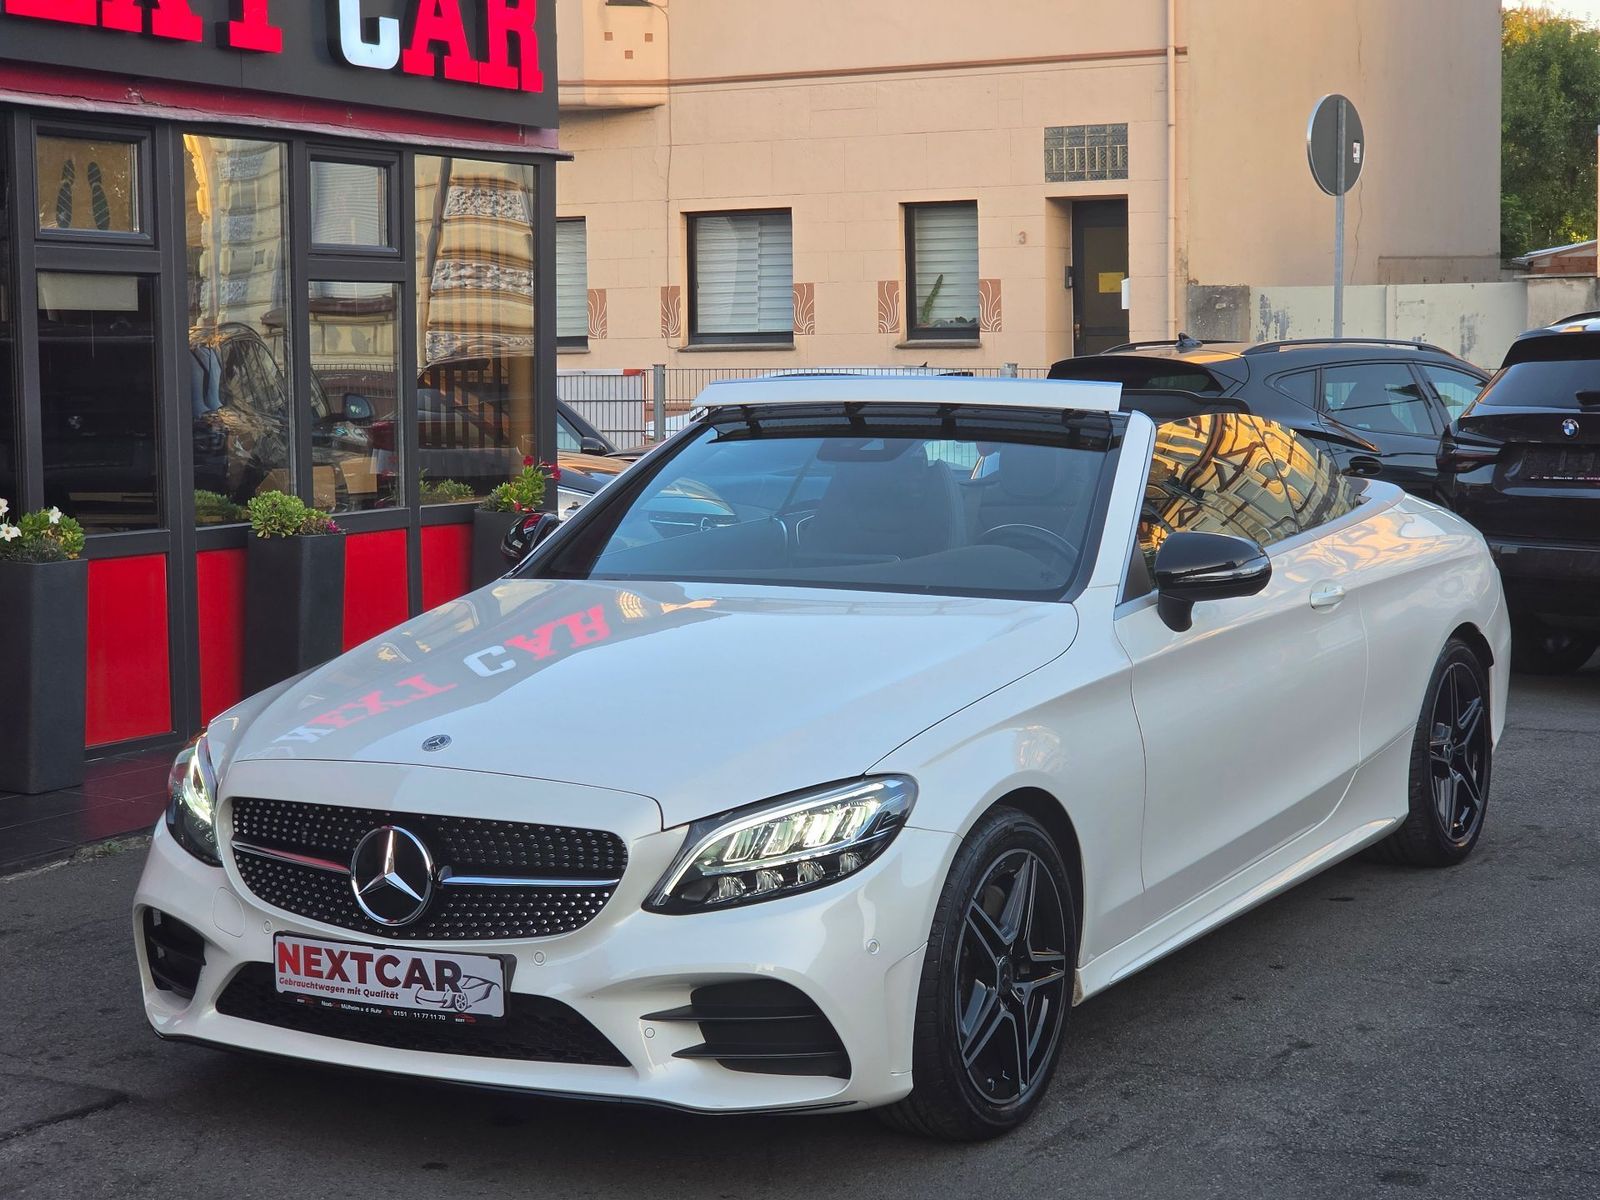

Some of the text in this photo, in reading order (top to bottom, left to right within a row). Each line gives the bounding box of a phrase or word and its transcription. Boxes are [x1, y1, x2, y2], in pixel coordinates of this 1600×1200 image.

[277, 941, 463, 994] NEXTCAR
[278, 976, 399, 1001] Gebrauchtwagen mit Qualität
